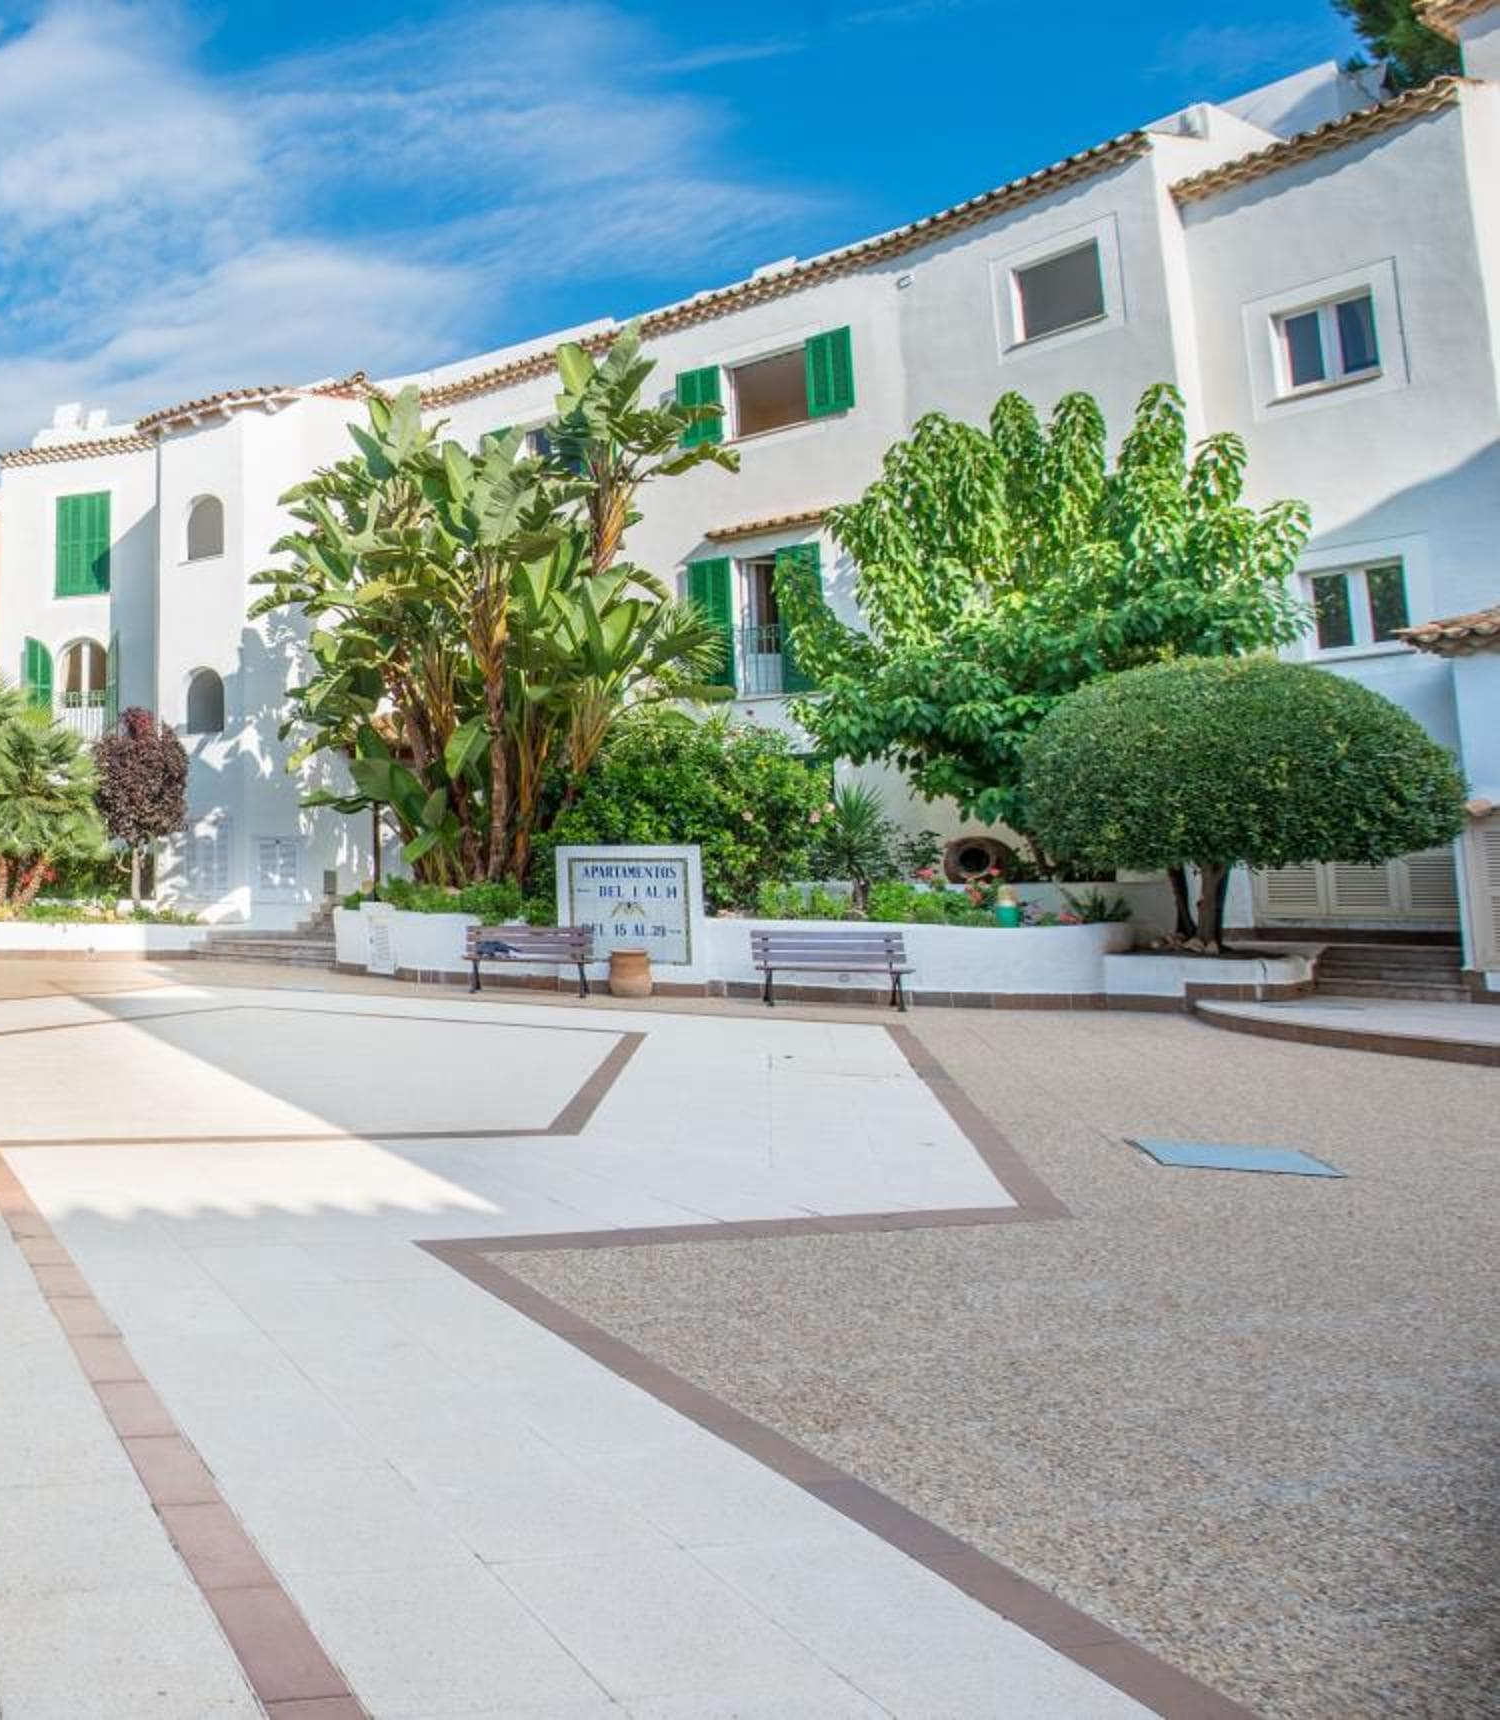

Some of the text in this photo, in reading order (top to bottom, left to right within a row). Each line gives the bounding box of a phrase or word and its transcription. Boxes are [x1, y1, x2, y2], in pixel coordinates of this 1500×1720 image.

[582, 866, 677, 879] APARTAMENTOS
[599, 885, 624, 898] DEL
[645, 885, 660, 898] AL
[614, 923, 627, 937] 15
[632, 923, 647, 937] AL
